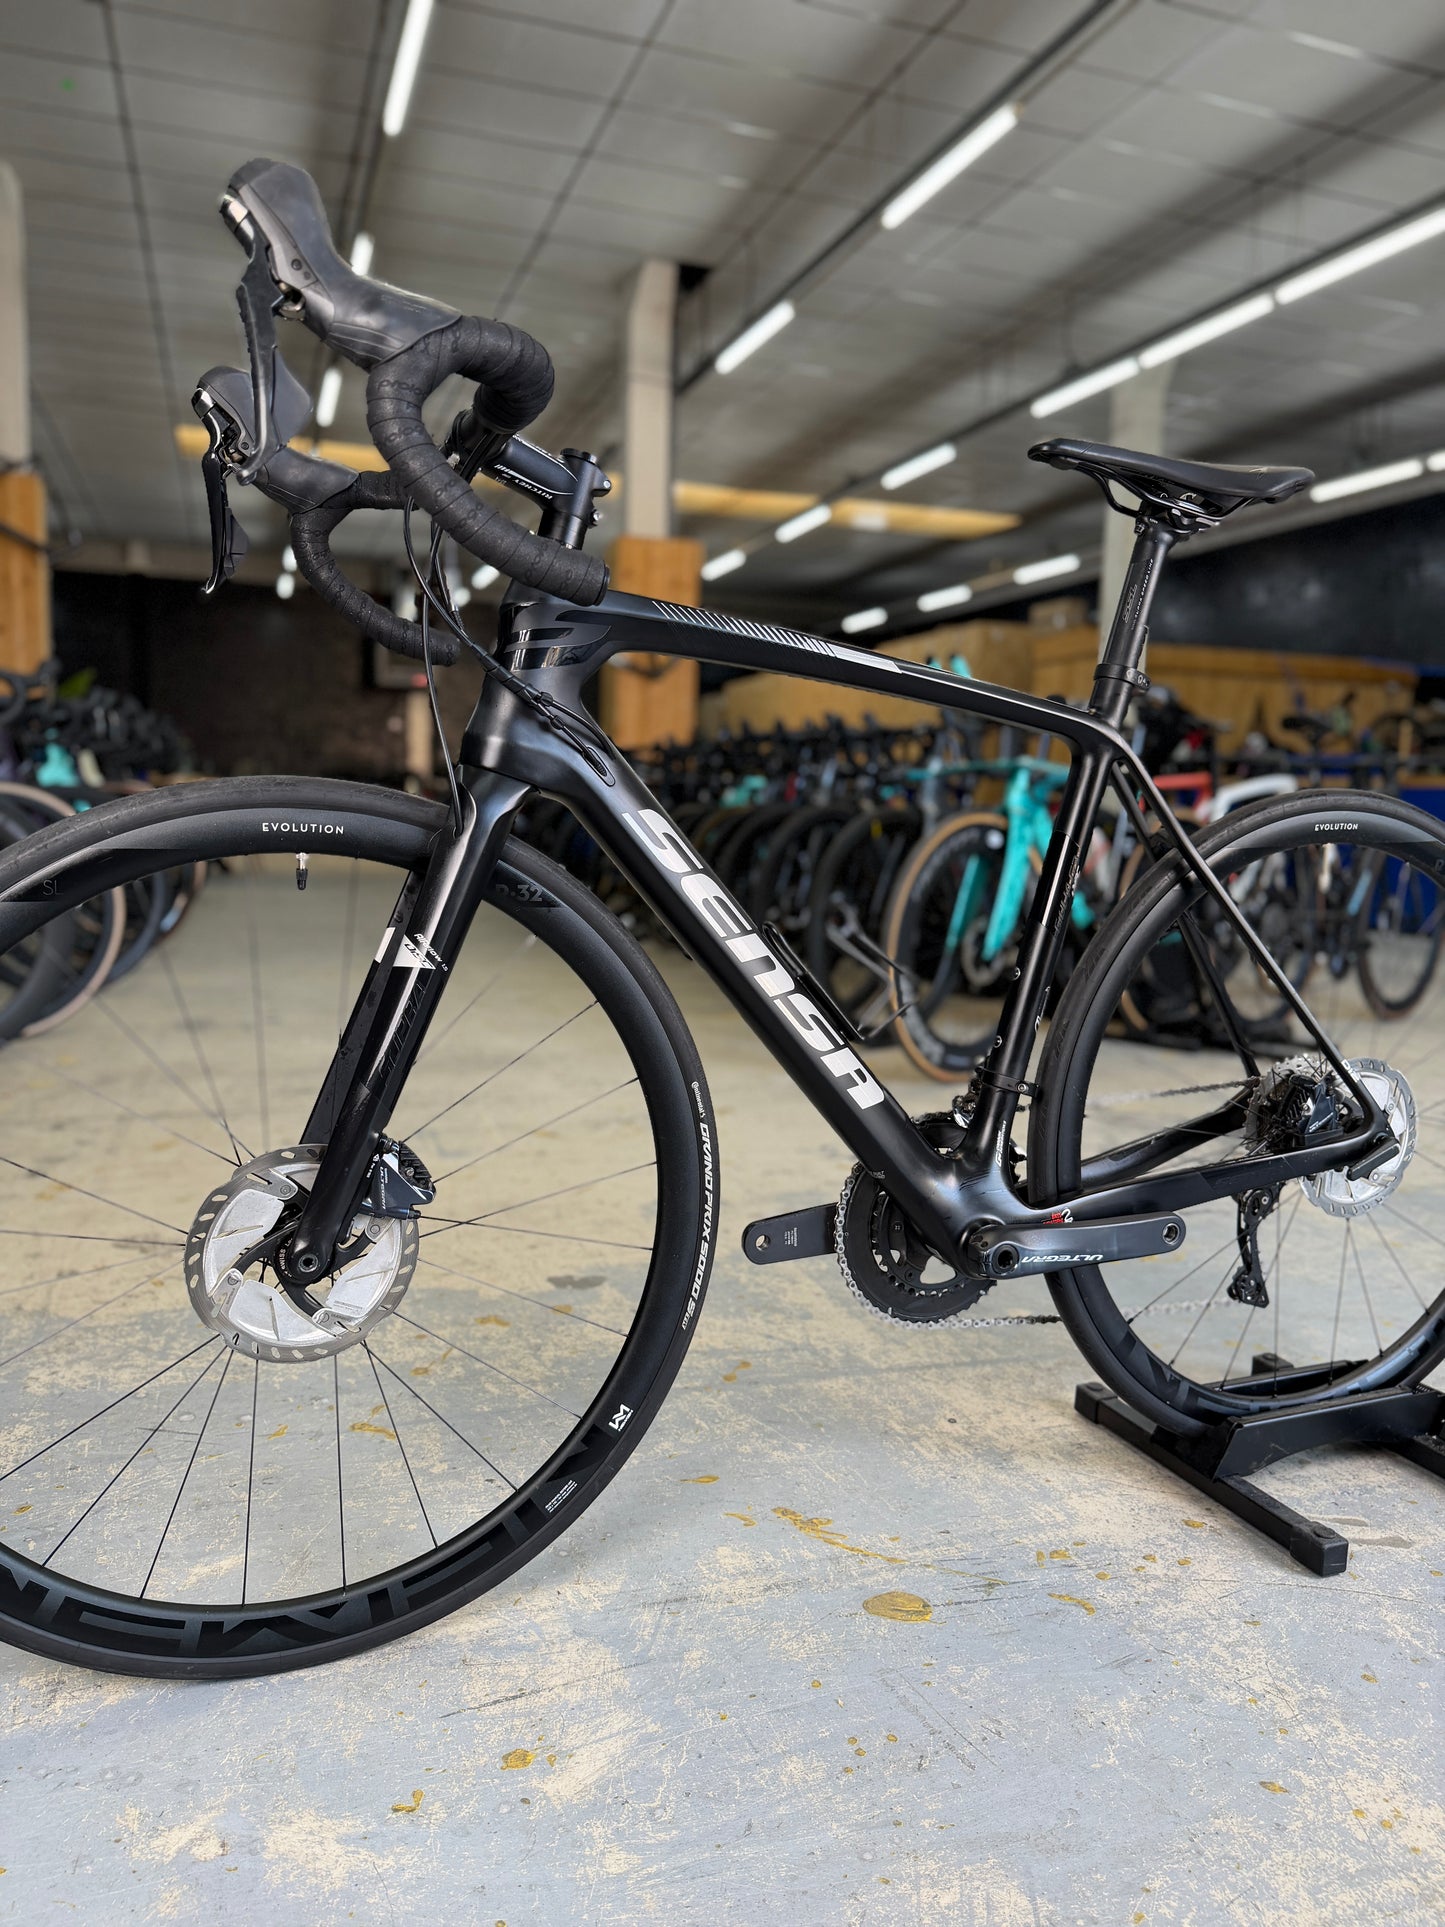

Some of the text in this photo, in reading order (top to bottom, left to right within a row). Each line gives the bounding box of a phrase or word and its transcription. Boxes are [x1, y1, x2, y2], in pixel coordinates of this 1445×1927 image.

[513, 479, 553, 500] RITCHEY
[262, 822, 343, 834] EVOLUTION
[1314, 823, 1359, 832] EVOLUTION
[42, 879, 64, 895] SL
[691, 1081, 704, 1114] Continental
[700, 1122, 713, 1190] GRAND
[379, 1166, 387, 1210] ULTEGRA
[702, 1193, 713, 1243] PRIX
[691, 1240, 709, 1301] 5000
[1021, 1254, 1104, 1263] ULTEGRA
